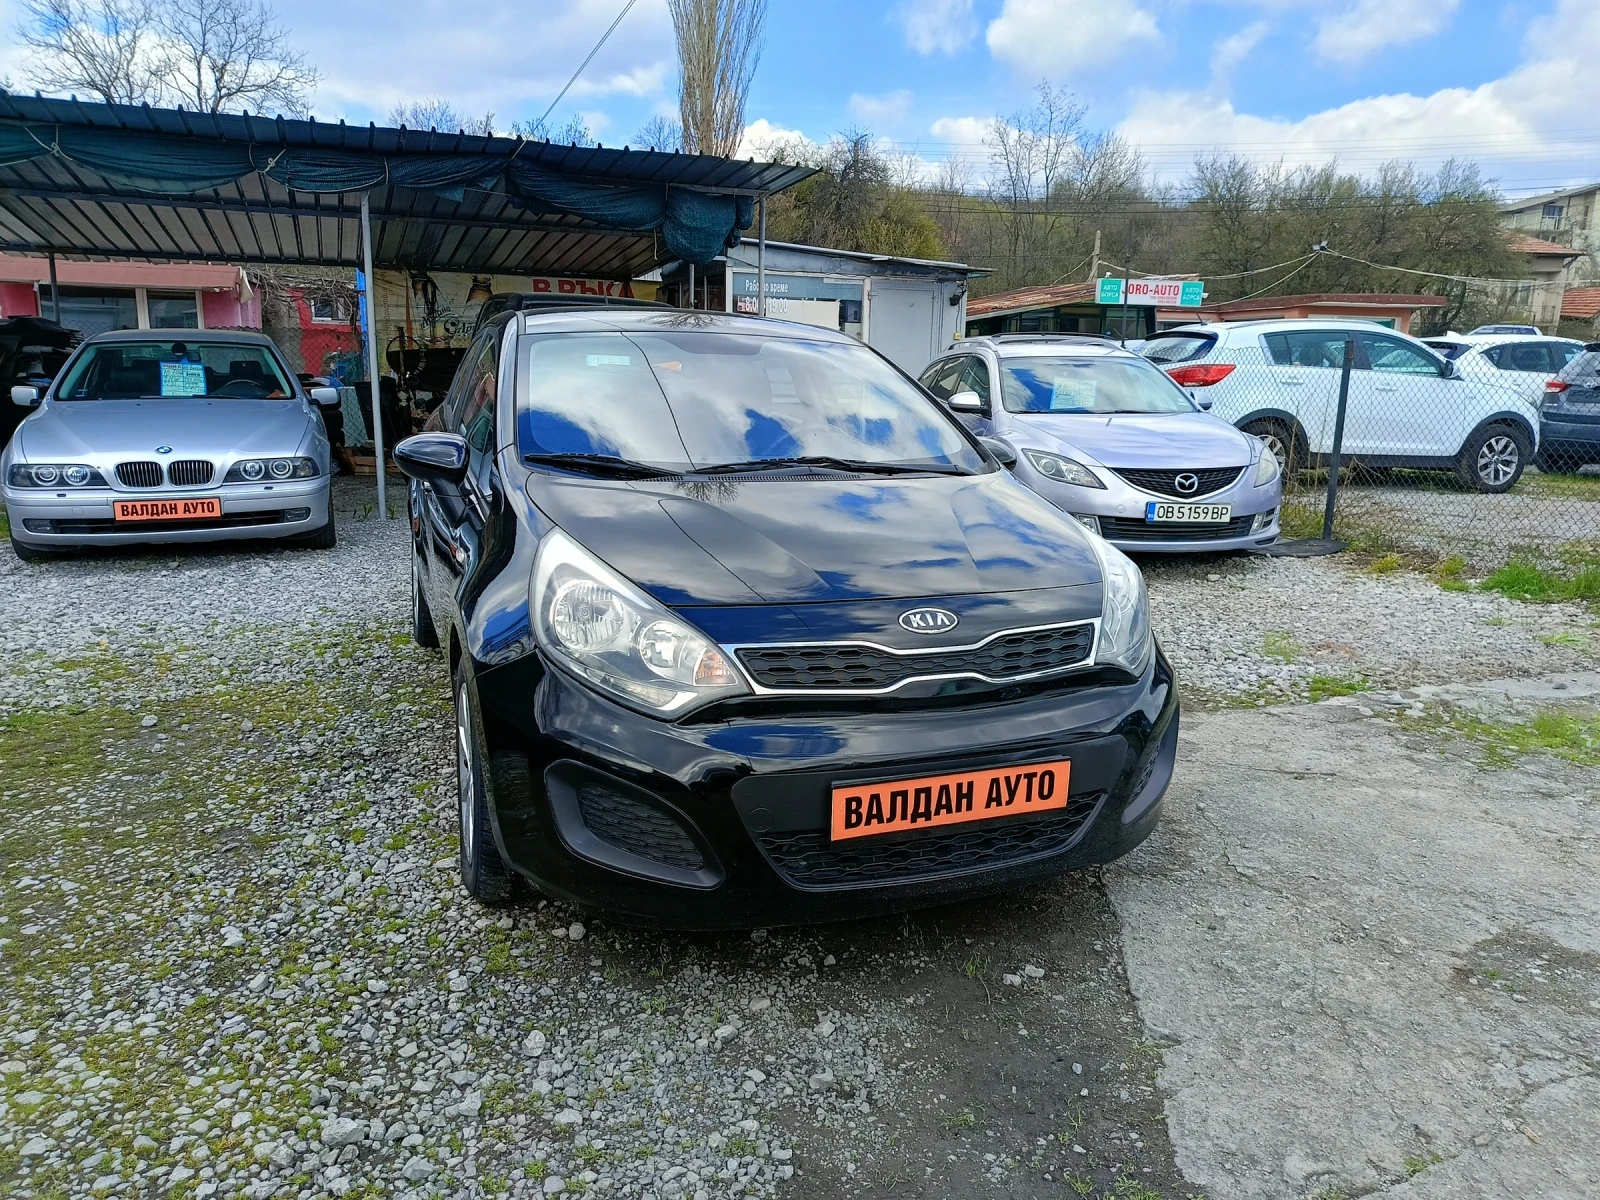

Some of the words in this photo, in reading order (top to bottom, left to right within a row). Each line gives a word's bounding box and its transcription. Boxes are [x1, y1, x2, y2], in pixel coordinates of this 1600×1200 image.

[745, 279, 769, 292] Рабоо
[770, 283, 789, 295] време
[121, 503, 178, 517] ВАЛДАН
[183, 501, 215, 514] АУТО
[1176, 506, 1210, 520] 5159
[908, 612, 951, 628] KIA
[844, 780, 975, 830] ВАЛДАН
[984, 769, 1056, 810] АУТО
